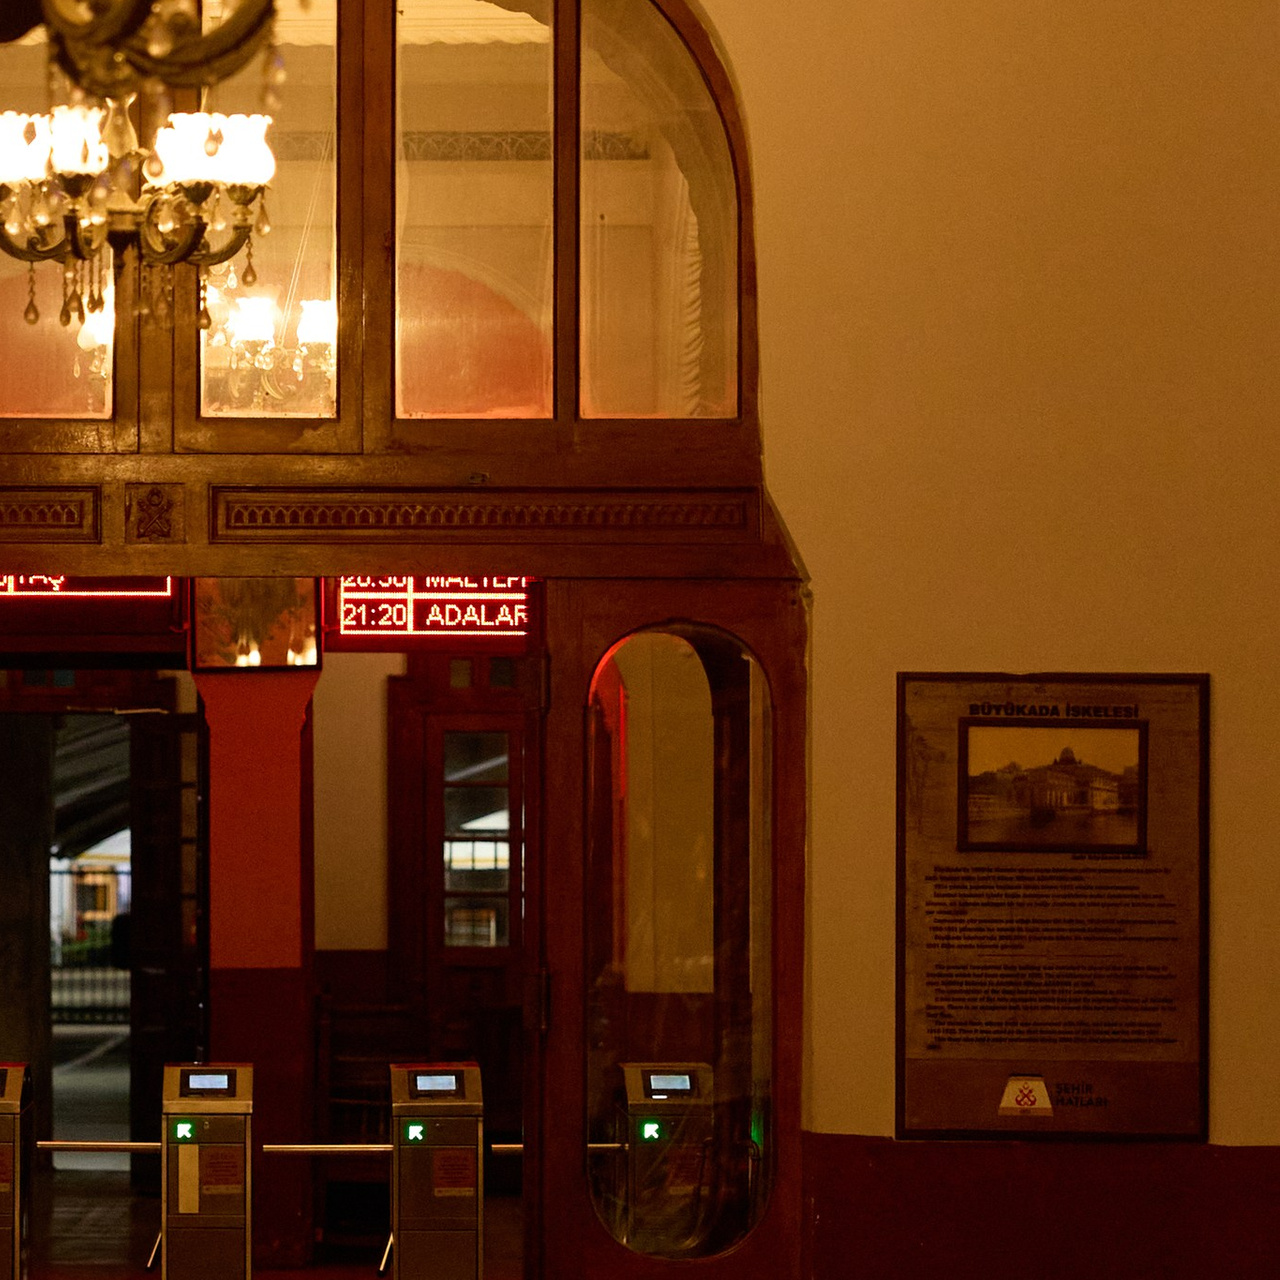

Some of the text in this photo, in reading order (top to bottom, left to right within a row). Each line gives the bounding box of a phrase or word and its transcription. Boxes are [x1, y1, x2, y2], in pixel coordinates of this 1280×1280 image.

[343, 603, 407, 625] 21:20
[968, 700, 1139, 718] BÜYÜKADA İSKELESİ
